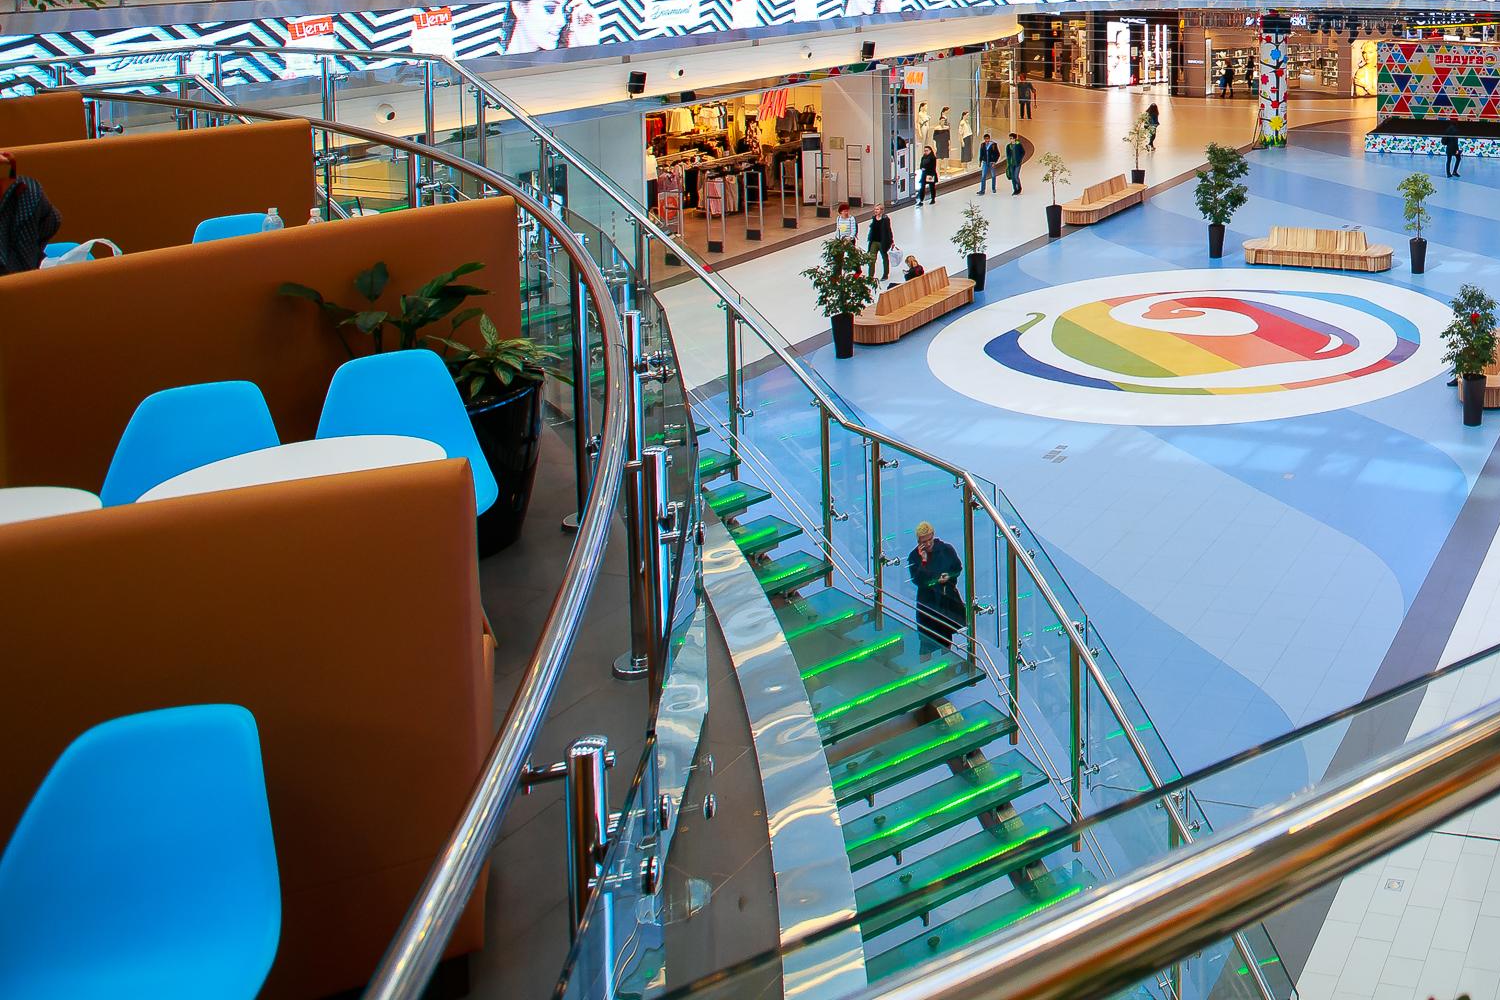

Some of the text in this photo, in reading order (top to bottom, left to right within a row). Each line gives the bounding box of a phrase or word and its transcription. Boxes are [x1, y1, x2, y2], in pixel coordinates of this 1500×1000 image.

[420, 12, 449, 27] Цепи
[294, 22, 330, 38] Цепи
[1435, 54, 1484, 65] радуга
[758, 88, 789, 121] H&M
